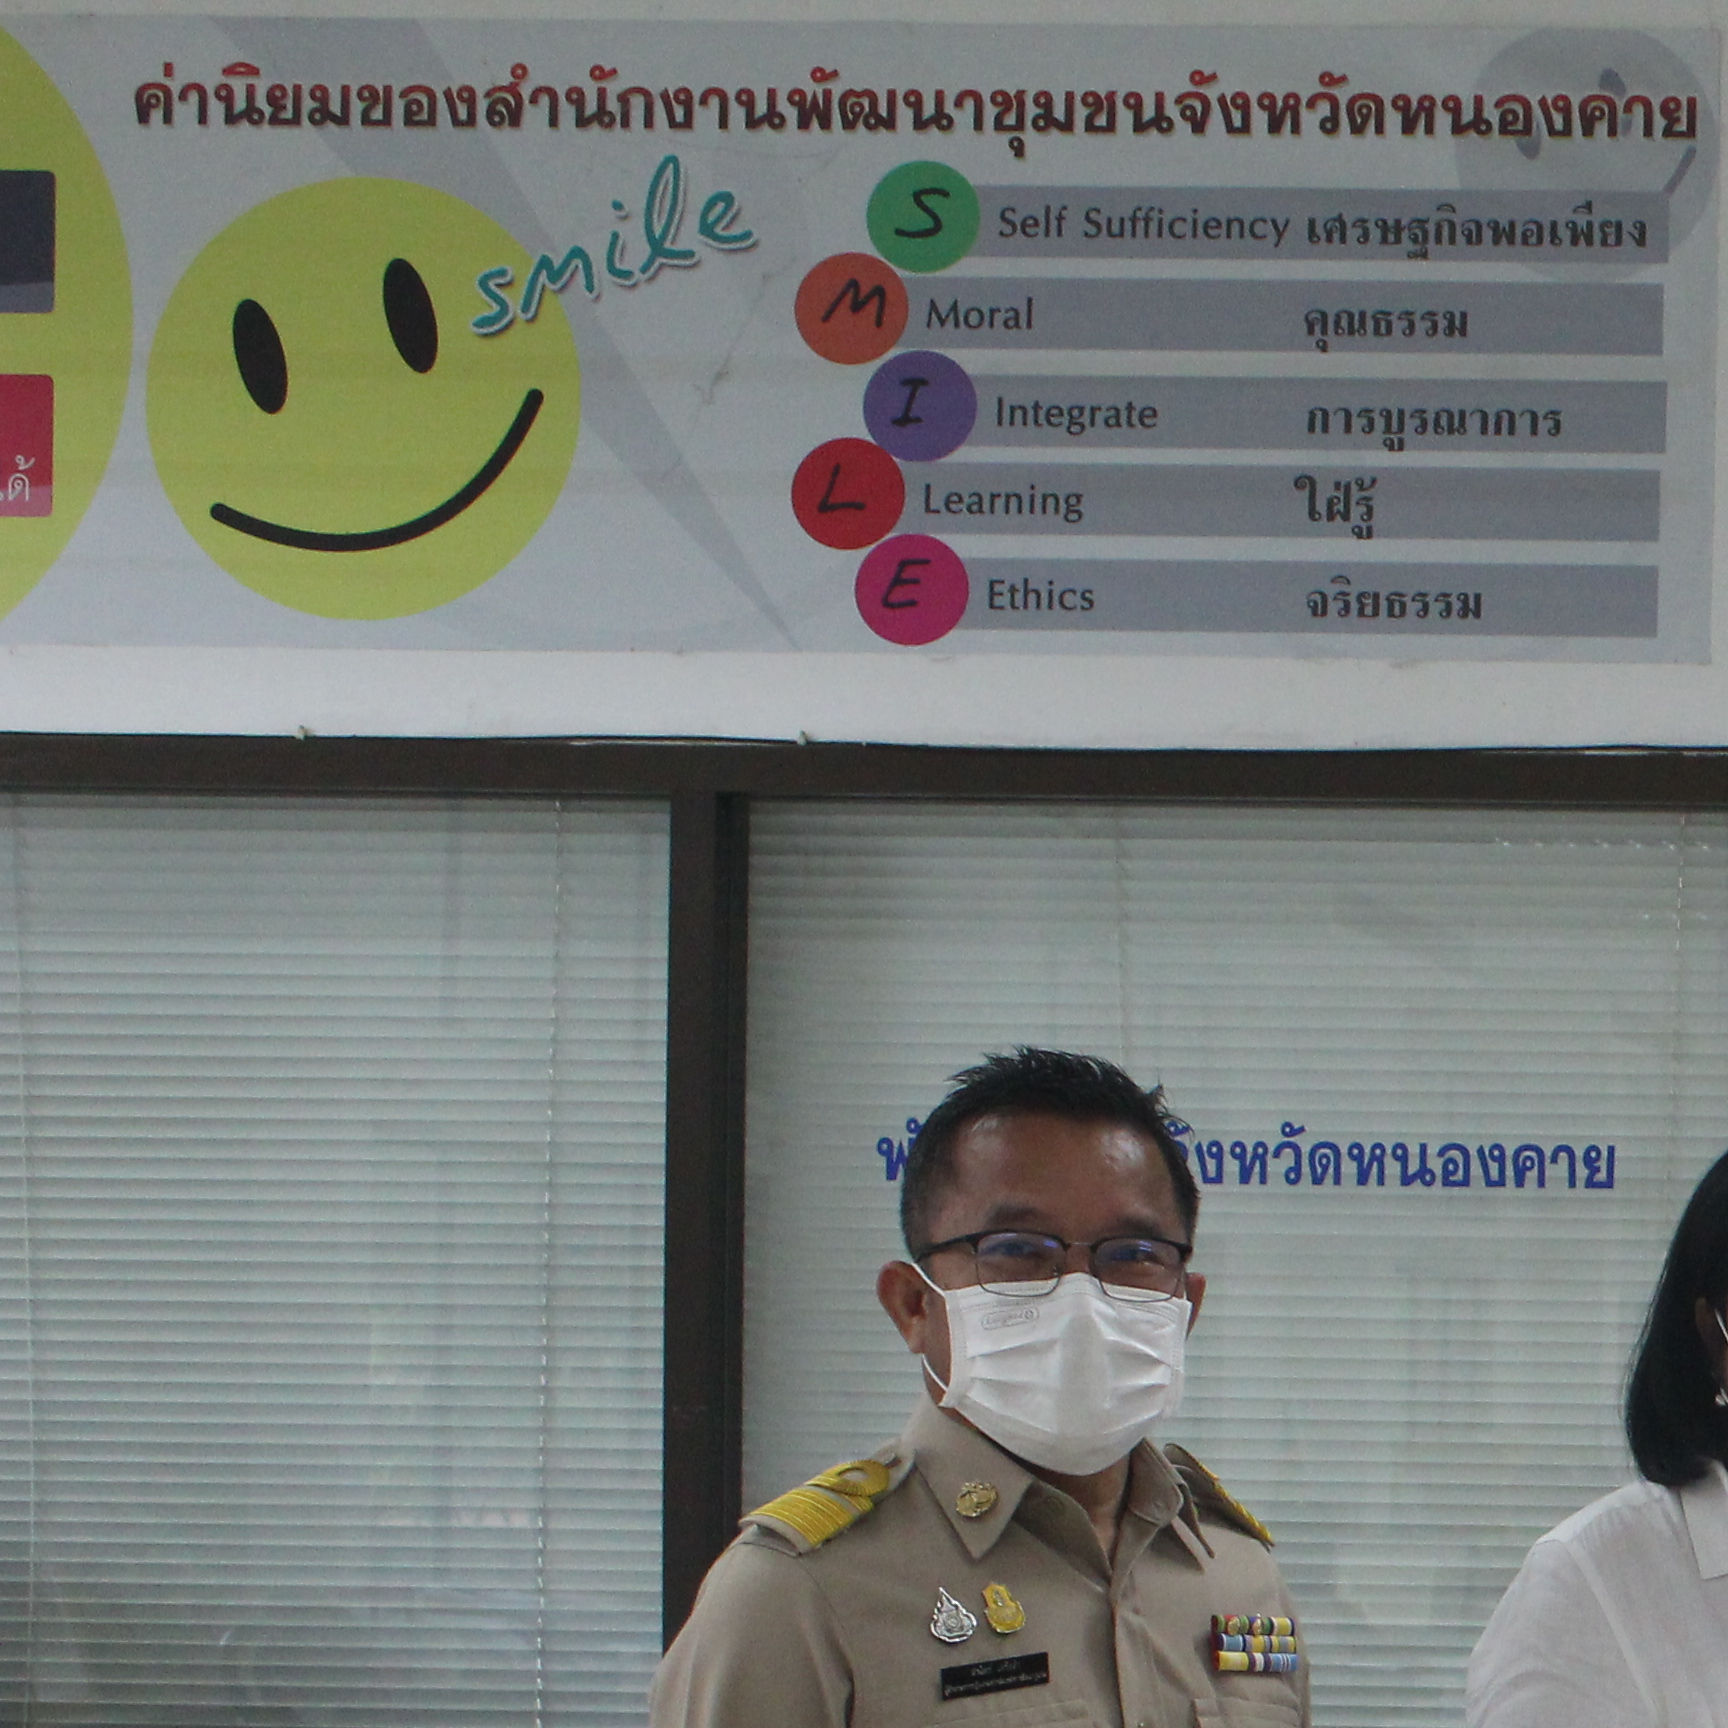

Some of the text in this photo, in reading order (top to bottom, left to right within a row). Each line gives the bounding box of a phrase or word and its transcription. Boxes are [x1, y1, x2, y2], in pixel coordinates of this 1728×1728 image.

[134, 63, 1699, 157] ค่านิยมของสำนักงานพัฒนาชุมชนจังหวัดหนองคาย
[895, 187, 951, 239] S
[998, 207, 1290, 250] Self Sufficiency
[1306, 200, 1648, 260] เศรษฐกิจพอเพียง
[822, 278, 887, 329] M
[925, 297, 1034, 332] Moral
[1304, 308, 1469, 352] คุณธรรม
[891, 377, 930, 427] I
[995, 397, 1159, 438] Integrate
[1306, 406, 1563, 452] การบูรณาการ
[818, 463, 867, 513] L
[924, 485, 1084, 523] Learning
[1293, 474, 1377, 539] ใฝ่รู้
[881, 559, 931, 610] E
[988, 580, 1096, 613] Ethics
[1305, 575, 1483, 620] จริยธรรม
